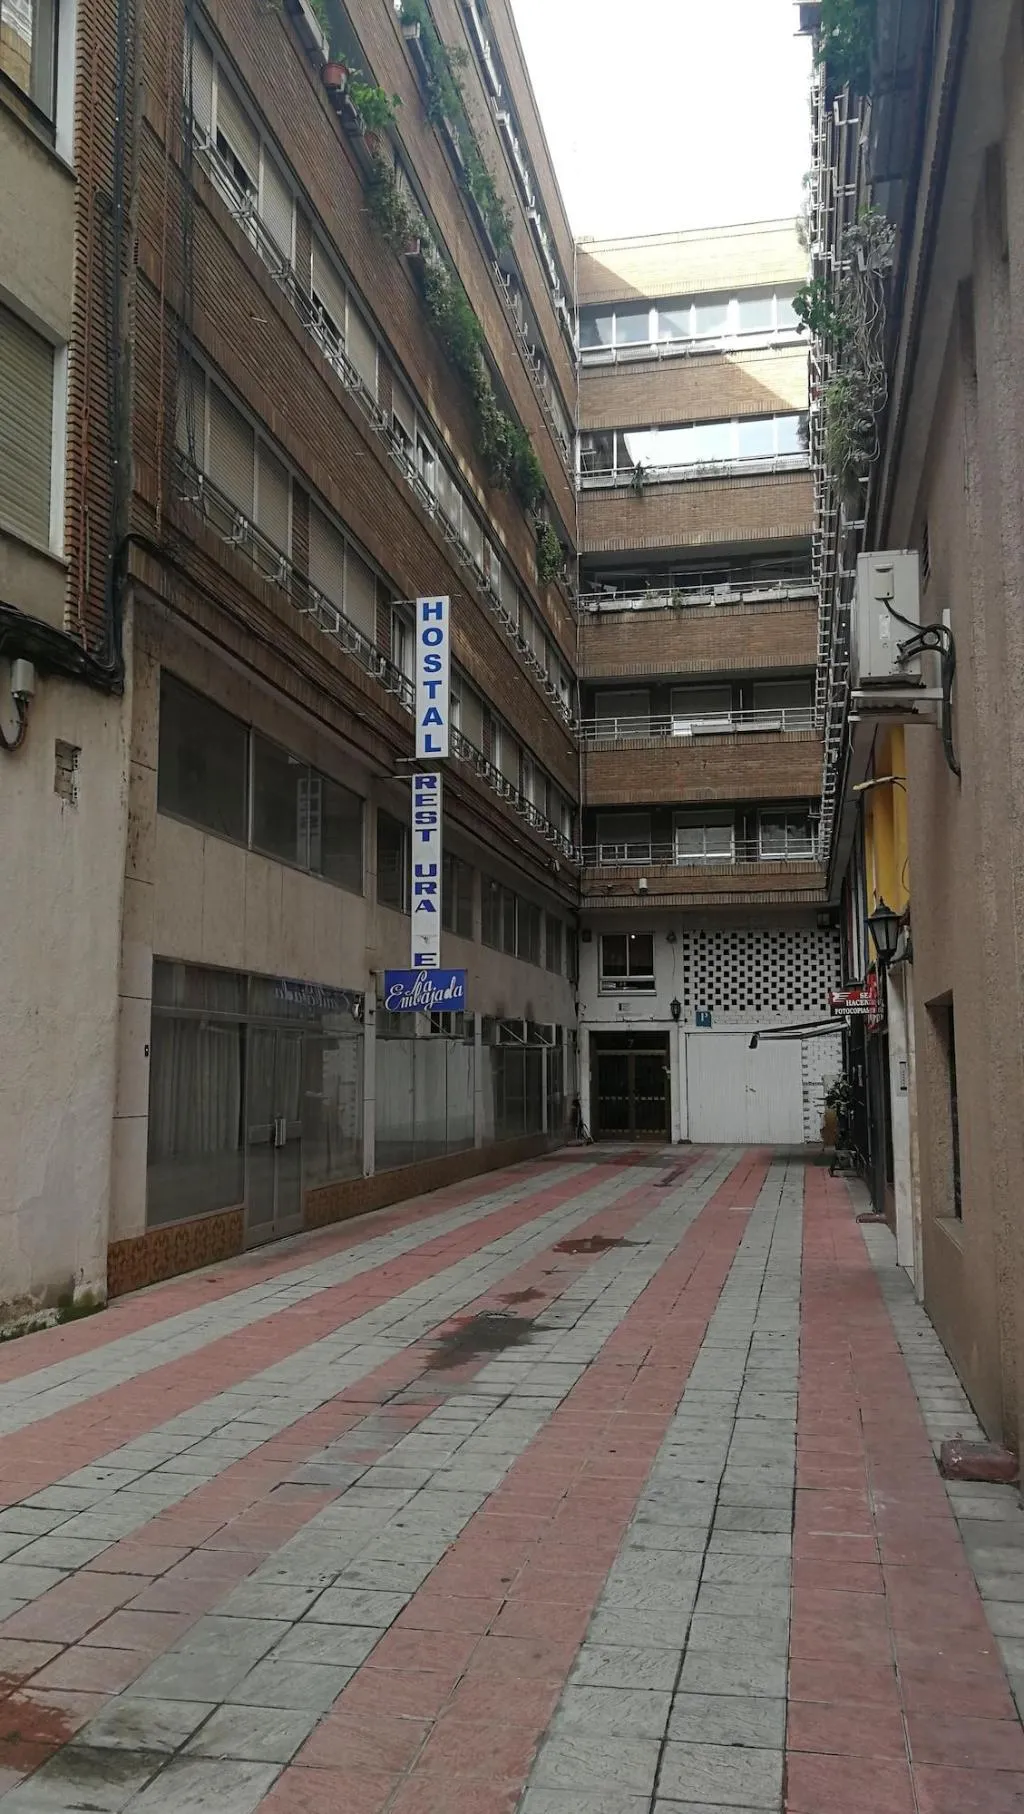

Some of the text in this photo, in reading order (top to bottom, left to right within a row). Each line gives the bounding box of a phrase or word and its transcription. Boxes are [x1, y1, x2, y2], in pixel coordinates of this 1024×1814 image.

[422, 602, 443, 753] HOSTAL
[385, 975, 463, 1011] Embajada
[411, 970, 432, 998] La
